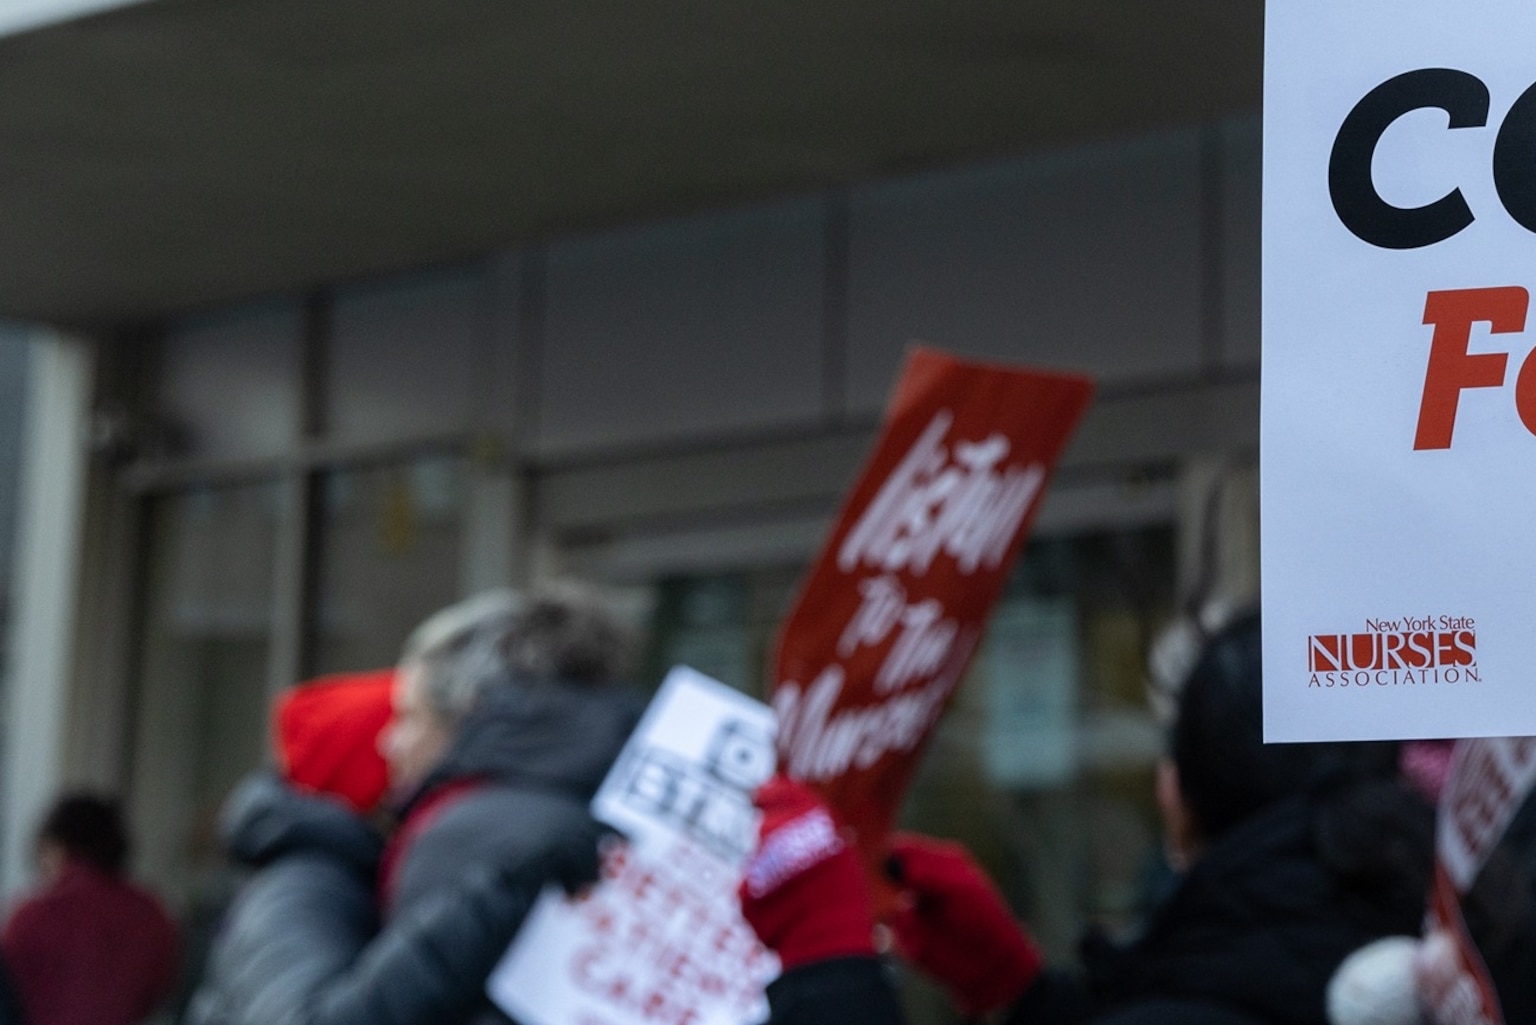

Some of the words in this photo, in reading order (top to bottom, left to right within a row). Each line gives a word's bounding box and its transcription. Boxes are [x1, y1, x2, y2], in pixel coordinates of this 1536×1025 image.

[1366, 618, 1401, 633] New
[1403, 614, 1437, 632] York
[1438, 614, 1476, 630] State
[1307, 628, 1477, 673] NURSES
[1307, 667, 1480, 688] ASSOCIATION
